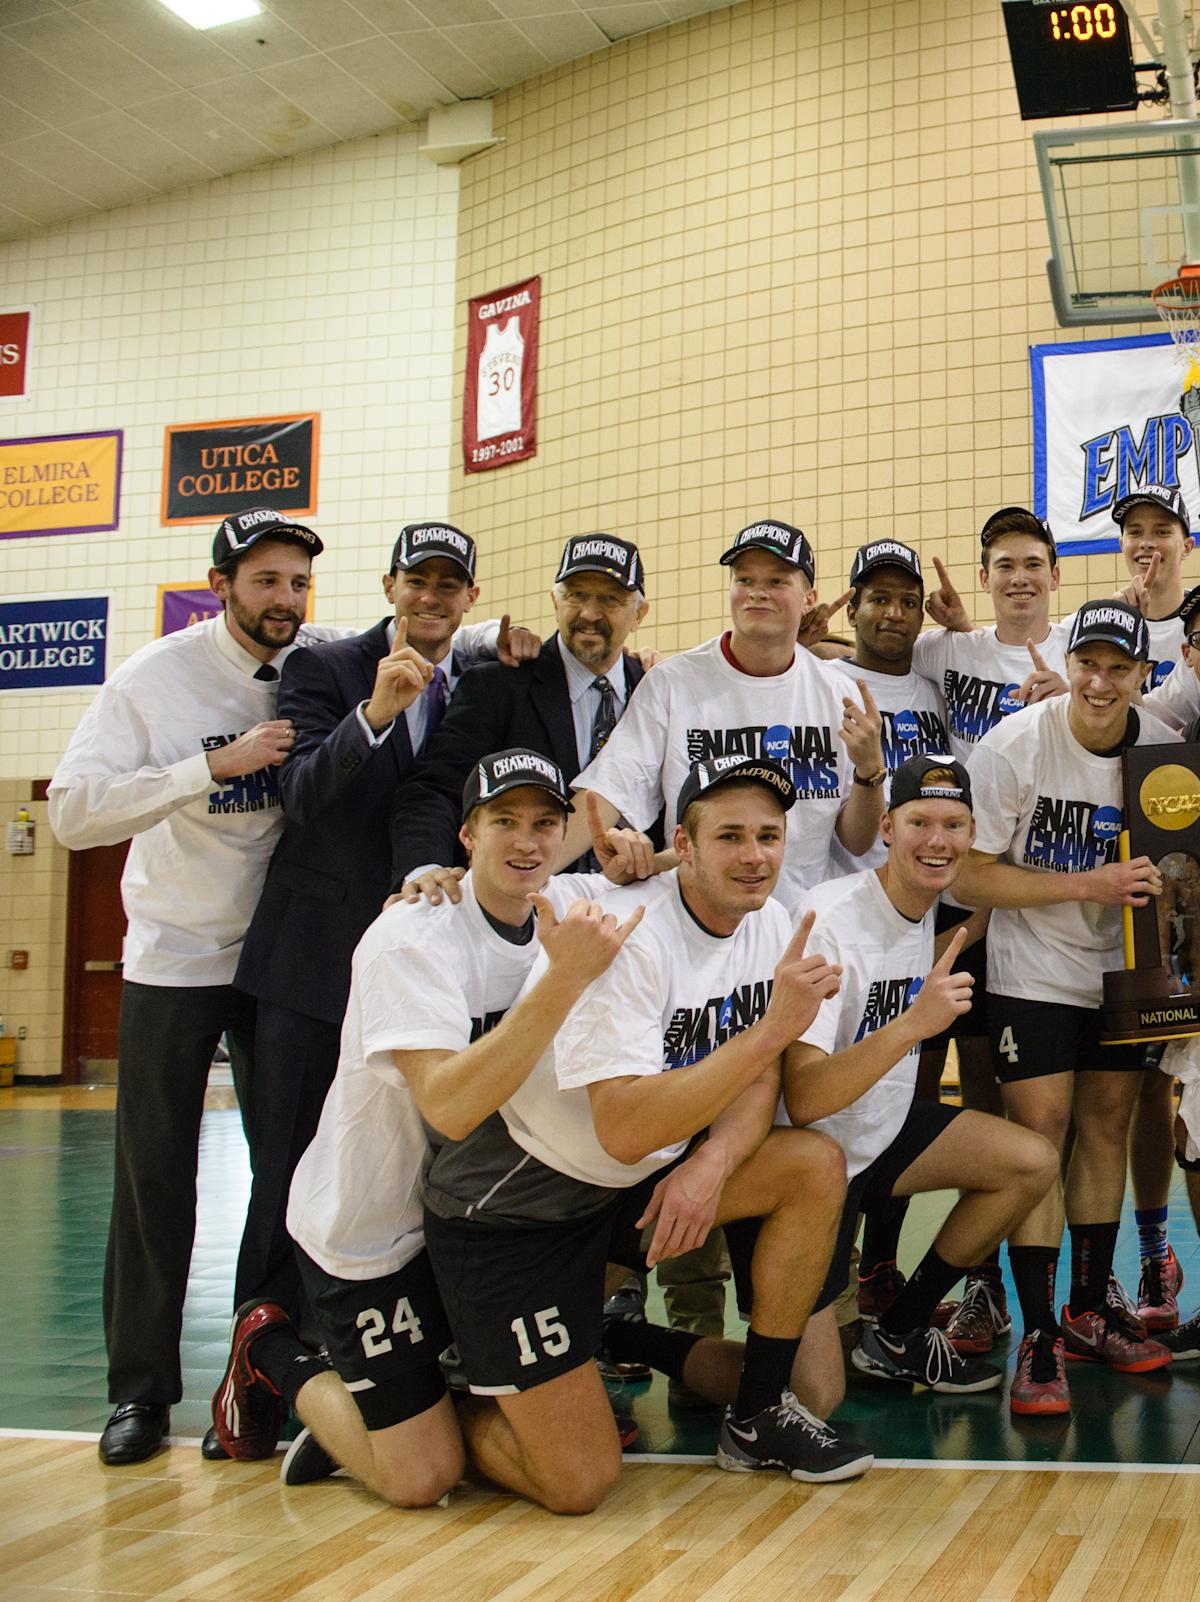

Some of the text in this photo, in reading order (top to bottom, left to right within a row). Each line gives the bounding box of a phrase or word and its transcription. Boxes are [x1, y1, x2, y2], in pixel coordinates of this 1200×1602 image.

[1051, 3, 1116, 41] 1:00
[478, 290, 532, 320] GAVINA
[488, 367, 515, 397] 30
[201, 443, 280, 469] UTICA
[472, 436, 524, 464] 1997-2001
[3, 461, 91, 486] ELMIRA
[178, 466, 300, 497] COLLEGE
[412, 527, 468, 556] CHAMPIONS
[739, 522, 791, 547] CHAMPIONS
[572, 540, 628, 566] CHAMPIONS
[866, 542, 912, 563] CHAMPIONS
[0, 619, 106, 645] ARTWICK
[1083, 608, 1135, 633] CHAMPIONS
[0, 645, 96, 671] OLLEGE
[896, 723, 919, 732] NCAA
[493, 754, 558, 784] CHAMPIONS
[208, 794, 279, 814] DIVISION III
[1093, 820, 1122, 832] NCAA
[1141, 1006, 1198, 1025] NATIONAL
[998, 1025, 1019, 1064] 4
[356, 1296, 424, 1359] 24
[510, 1305, 571, 1367] 15
